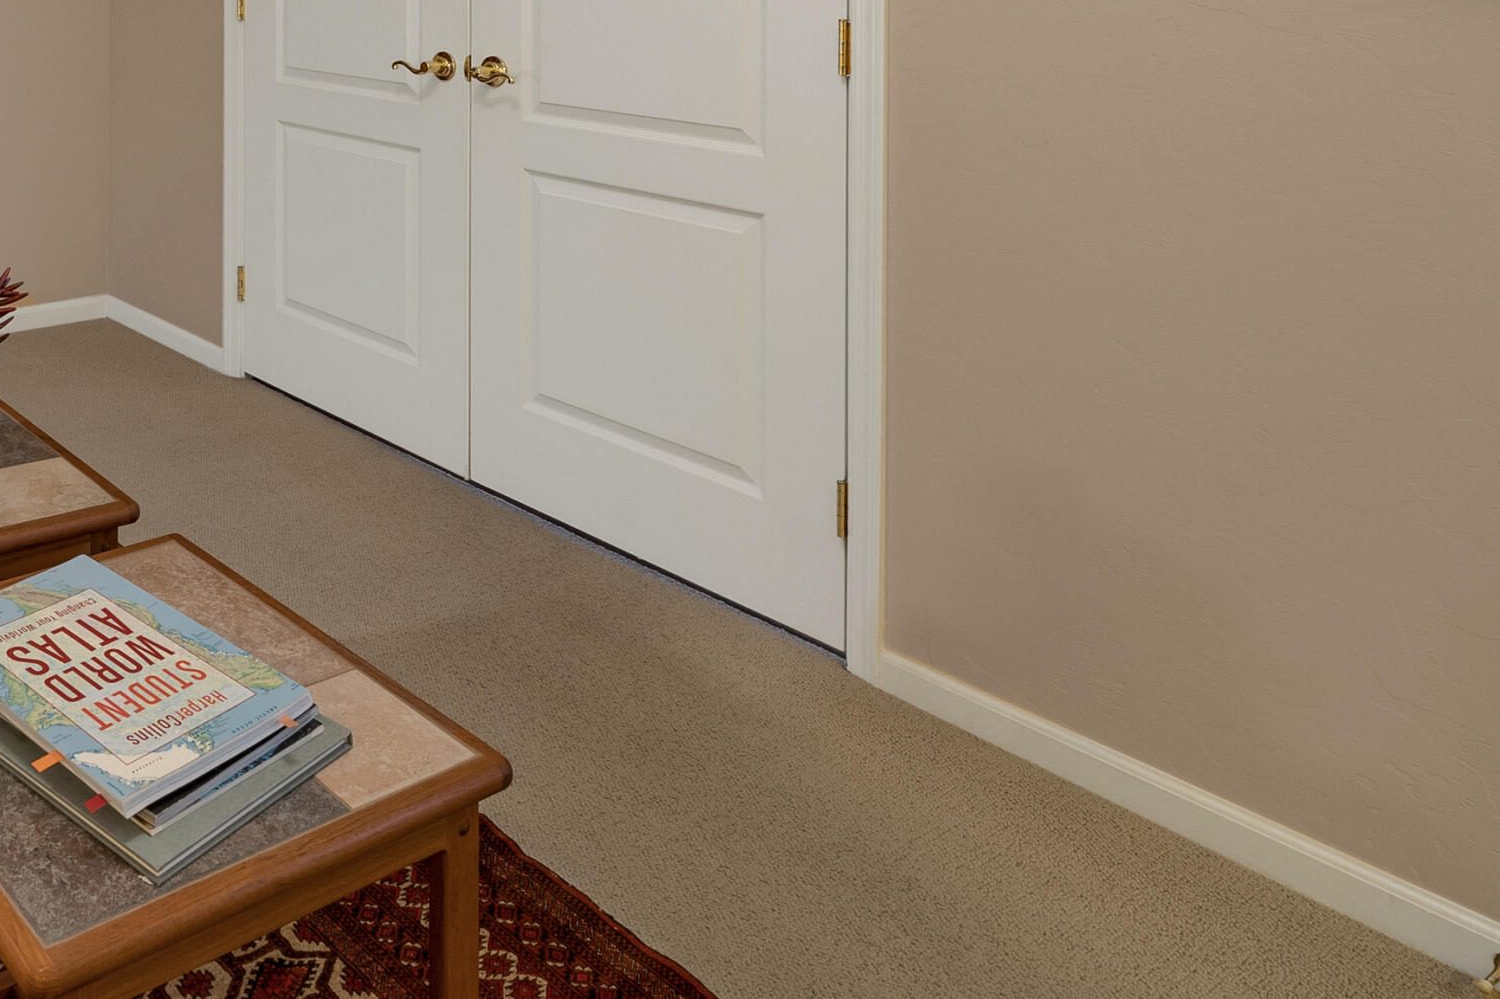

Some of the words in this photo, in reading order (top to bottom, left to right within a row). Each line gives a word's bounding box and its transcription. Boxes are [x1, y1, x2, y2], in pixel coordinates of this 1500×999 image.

[37, 614, 58, 627] Your
[55, 597, 96, 618] Changing
[6, 607, 133, 675] ATLAS
[44, 635, 175, 702] WORLD
[81, 660, 207, 731] STUDENT
[254, 705, 278, 721] ARCTIC
[126, 690, 228, 745] HarperCollins
[232, 719, 254, 734] OCEAN
